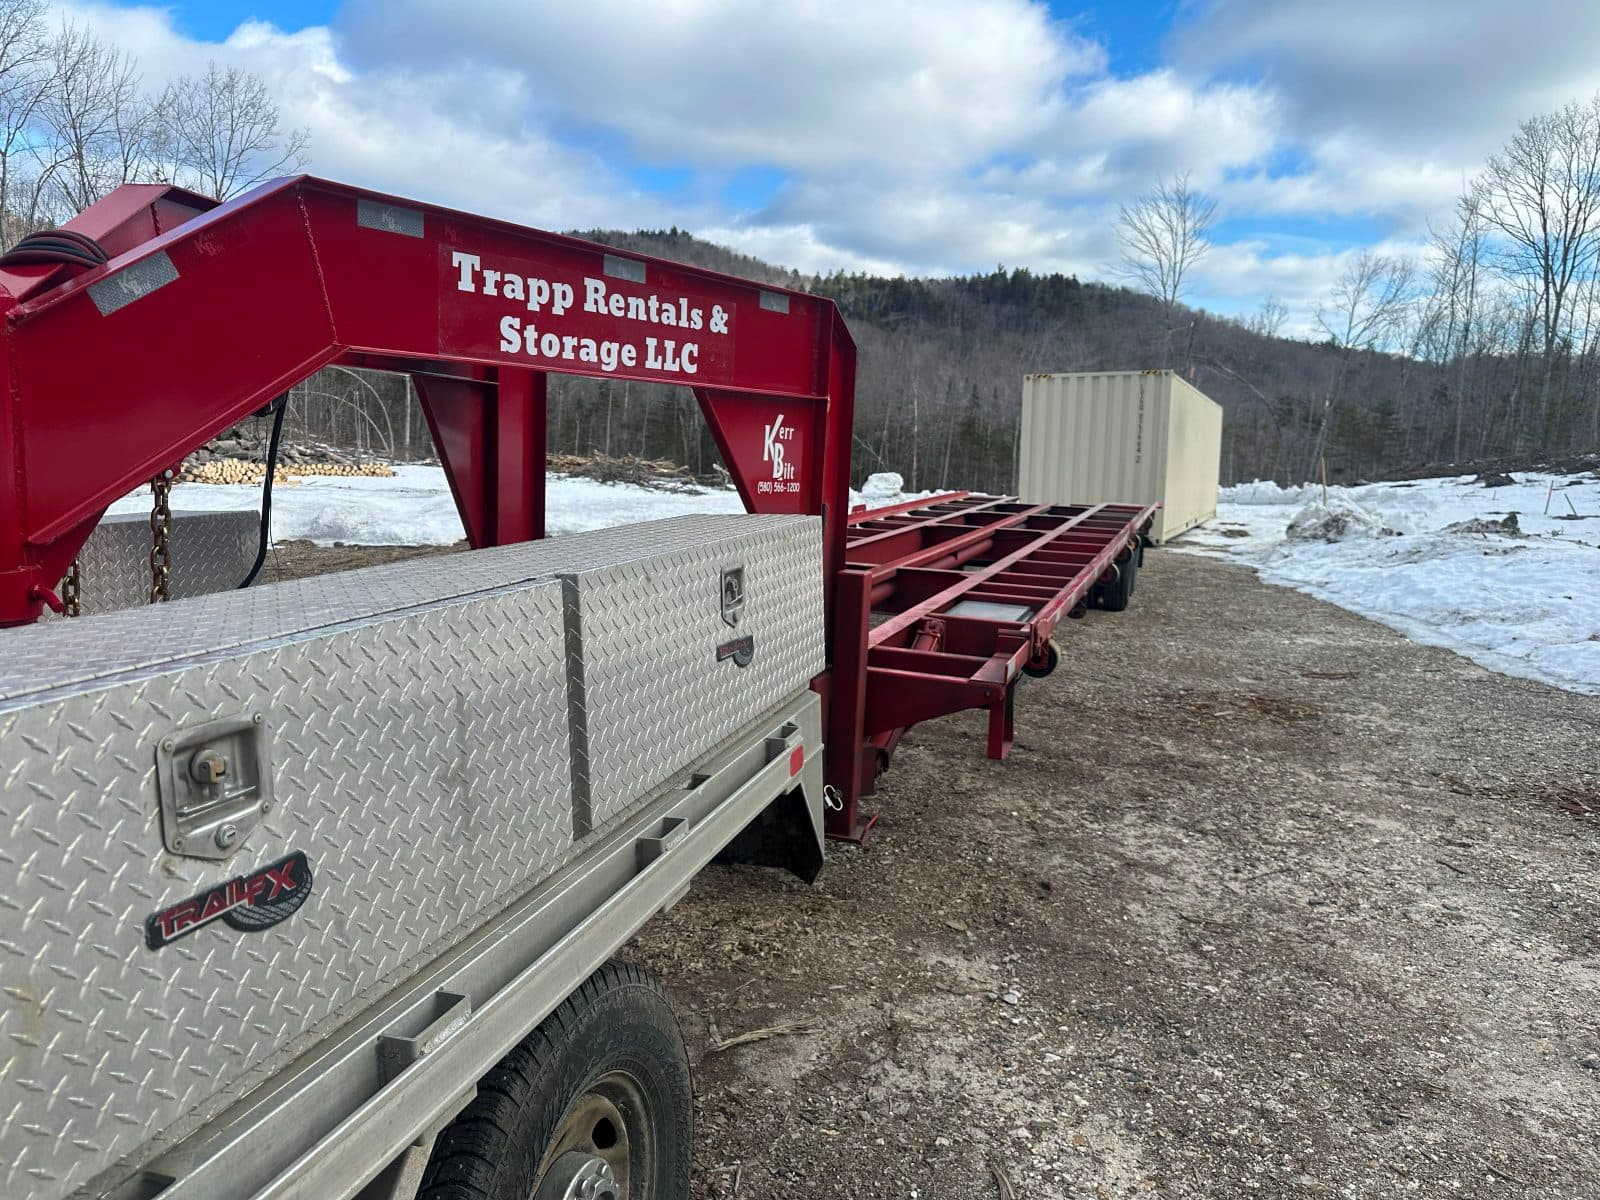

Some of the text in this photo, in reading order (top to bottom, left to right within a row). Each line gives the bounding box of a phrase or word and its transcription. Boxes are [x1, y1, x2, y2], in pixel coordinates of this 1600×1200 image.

[452, 250, 729, 335] Trapp Rentals &
[499, 315, 699, 374] Storage LLC
[763, 414, 795, 461] Kerr
[773, 442, 795, 481] Bilt
